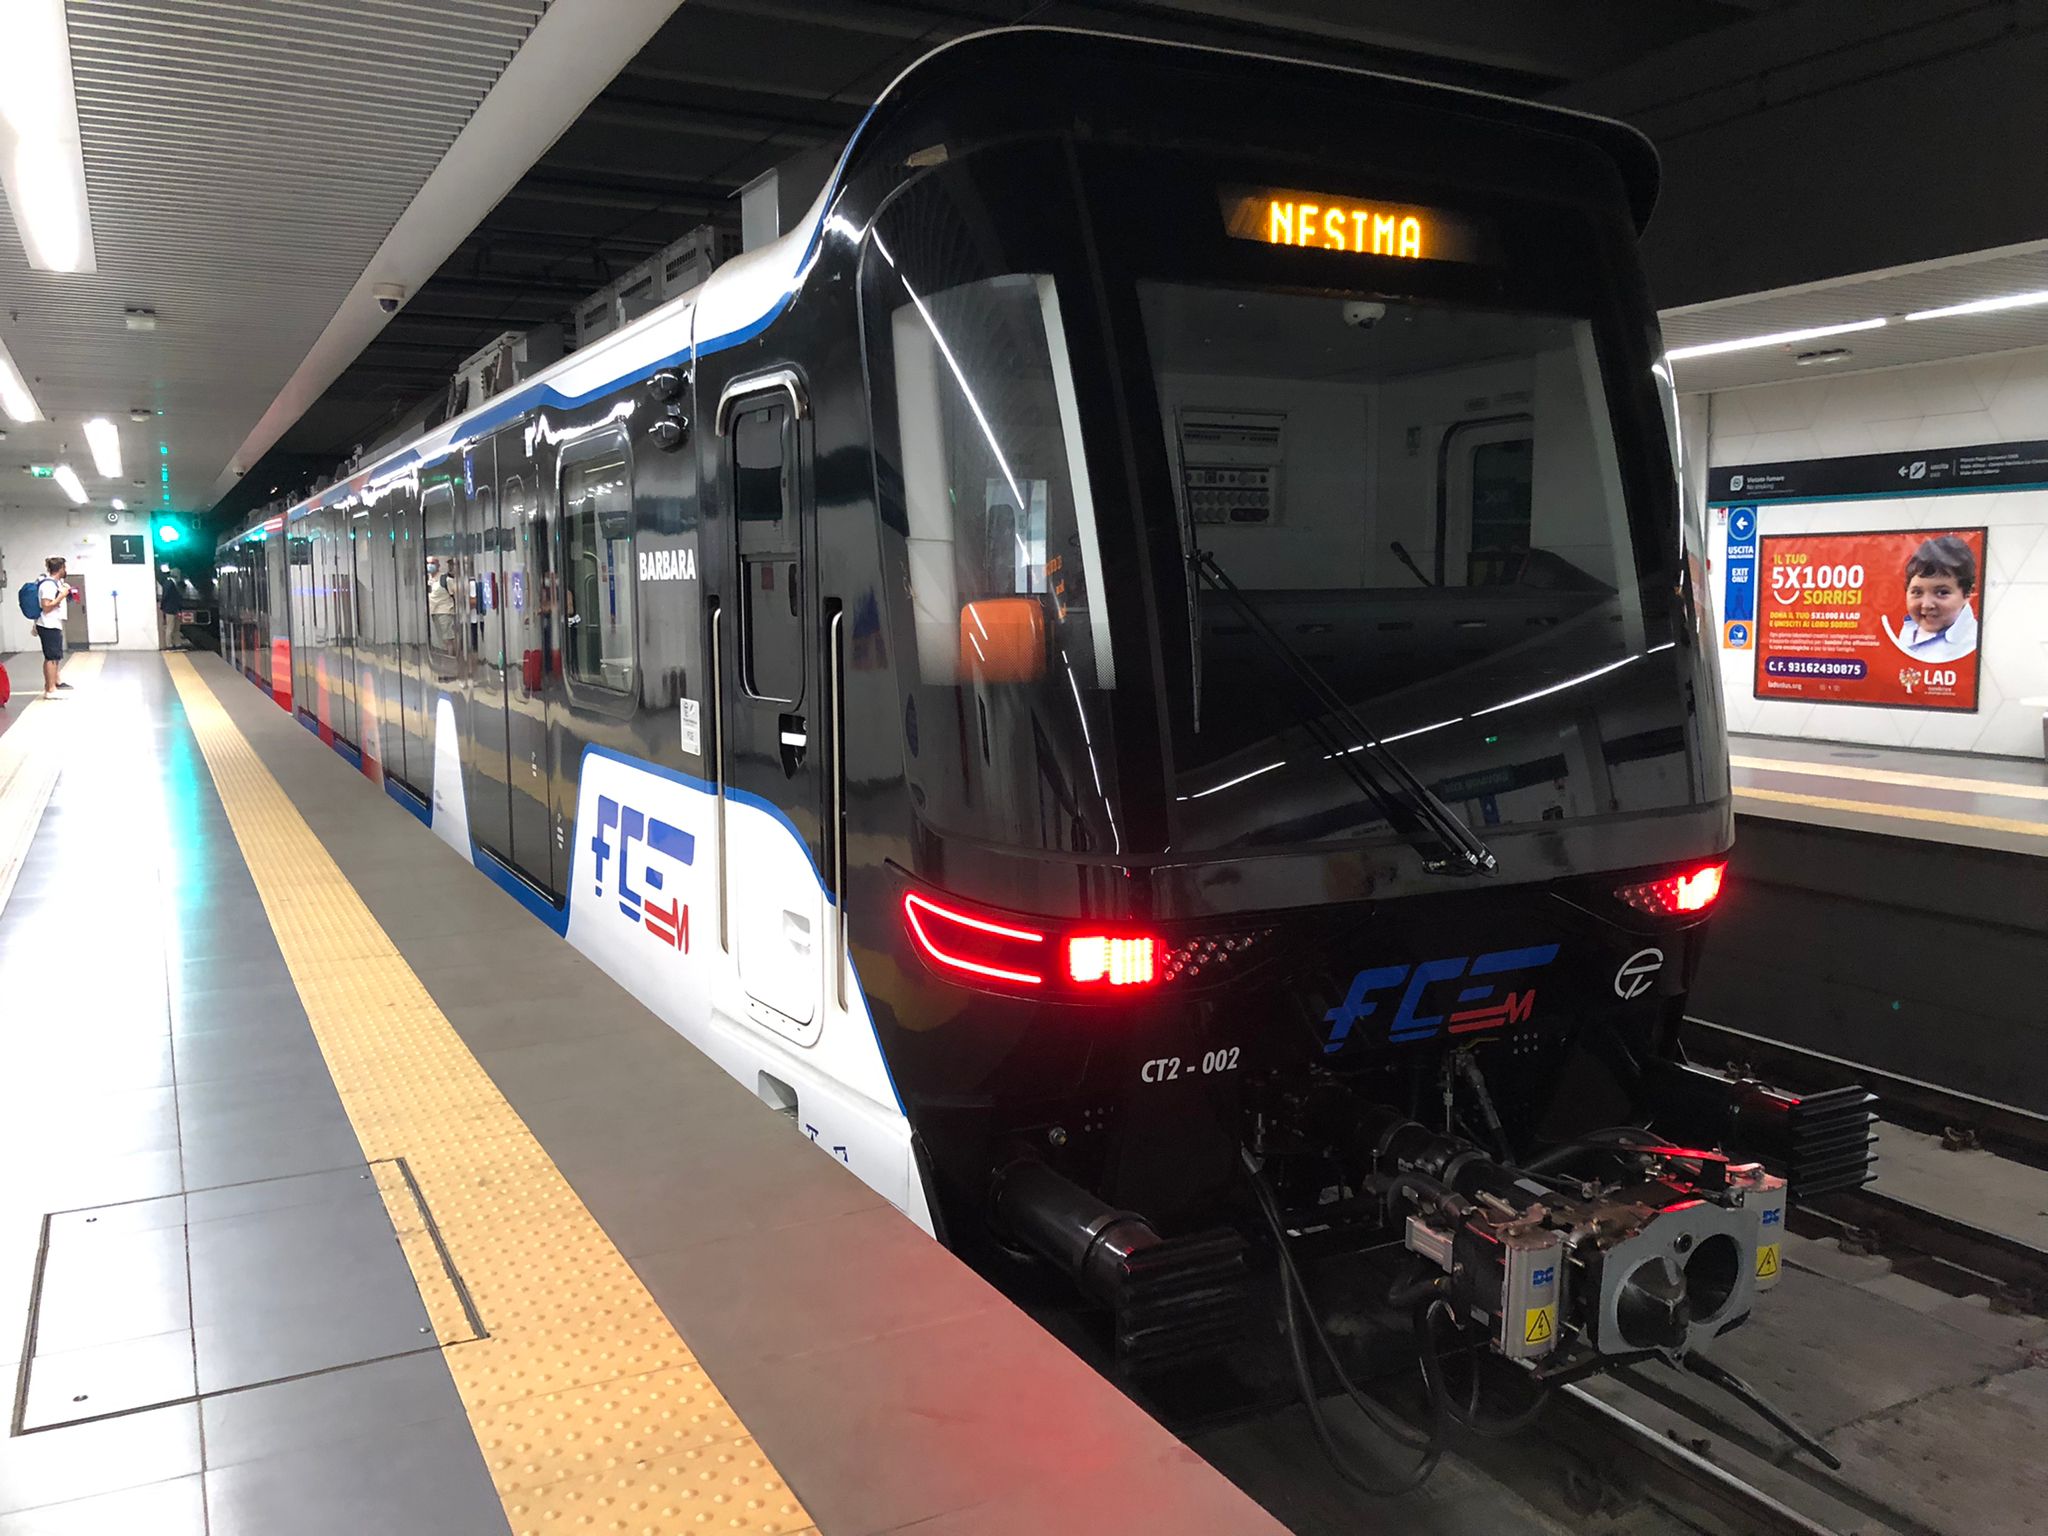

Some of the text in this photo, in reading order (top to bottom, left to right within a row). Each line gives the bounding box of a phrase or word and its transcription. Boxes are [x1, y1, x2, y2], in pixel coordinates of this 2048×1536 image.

[123, 539, 130, 553] 1
[1728, 546, 1754, 554] USCITA
[639, 549, 696, 580] BARBARA
[1785, 553, 1807, 564] TUO
[1732, 568, 1749, 576] EXIT
[1771, 565, 1864, 589] 5X1000
[1803, 590, 1862, 605] SORRISI
[1811, 612, 1838, 620] 5X1000
[1846, 612, 1860, 620] LAD
[1788, 663, 1861, 675] 93162430875
[1924, 669, 1957, 685] LAD
[1141, 1057, 1180, 1083] CT2
[1202, 1047, 1240, 1074] 002
